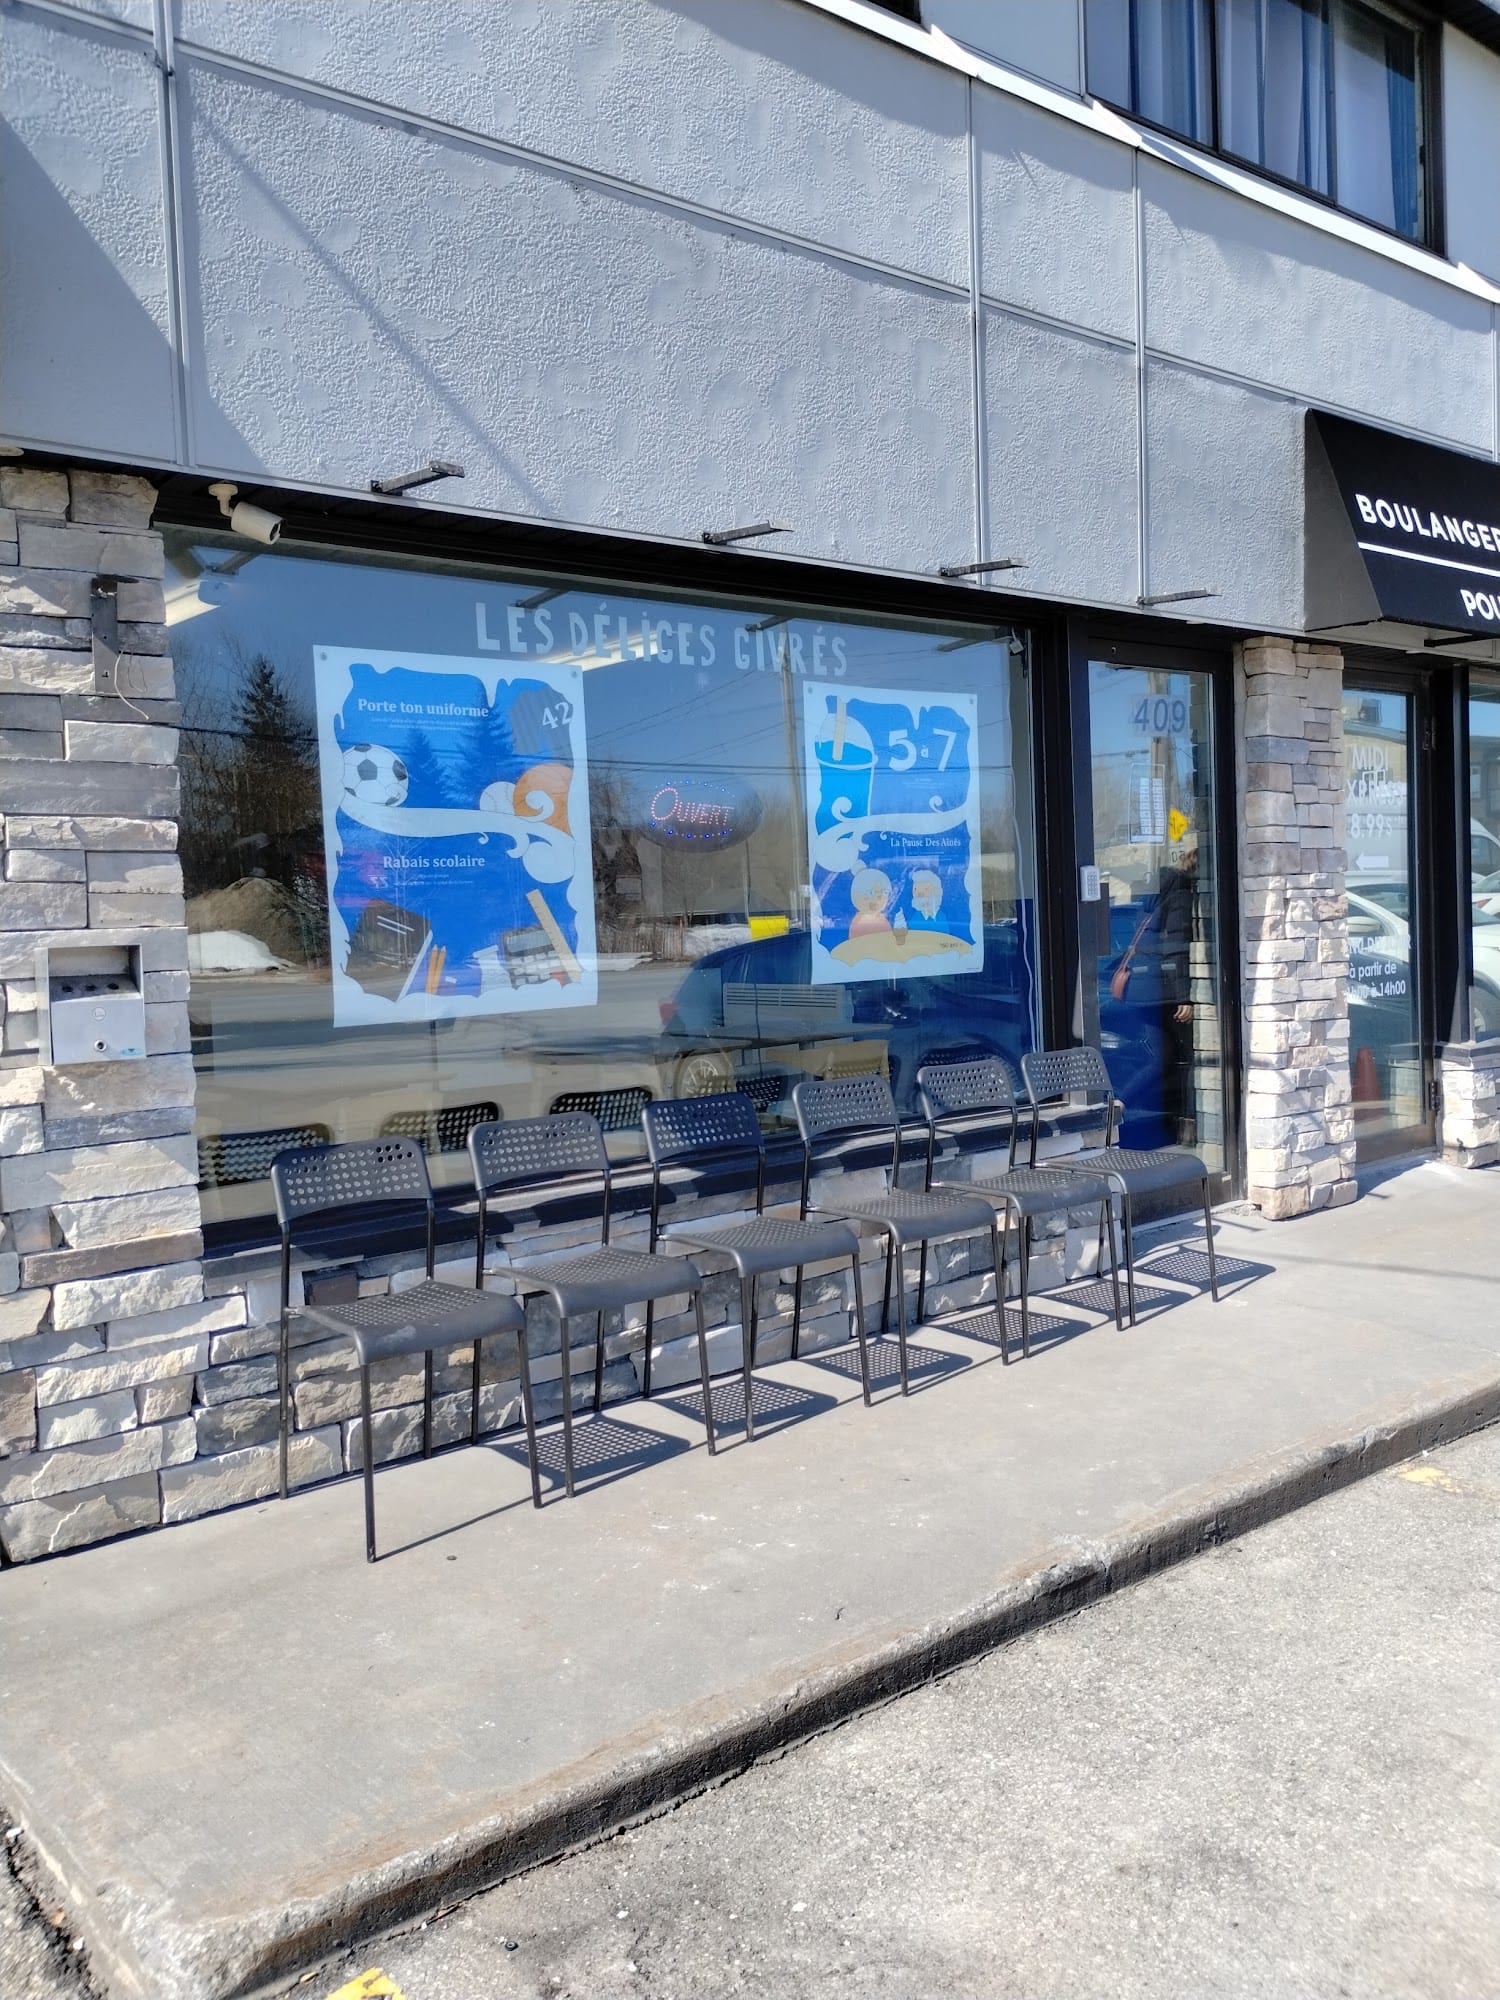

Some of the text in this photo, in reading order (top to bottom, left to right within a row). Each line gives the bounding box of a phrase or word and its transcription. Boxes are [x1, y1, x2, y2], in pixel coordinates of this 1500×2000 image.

[475, 602, 554, 654] LES
[358, 699, 489, 717] Porte ton uniforme
[543, 701, 571, 729] 42
[1134, 697, 1186, 734] 409
[889, 729, 917, 771] 5
[932, 728, 957, 772] 7
[1352, 745, 1389, 771] MIDI
[1350, 813, 1393, 838] 8.99$
[890, 837, 900, 847] La
[902, 837, 924, 848] Pause
[925, 837, 940, 847] Des
[383, 854, 485, 868] Rabais scolaire
[1349, 960, 1397, 981] à partir de
[1379, 980, 1406, 997] 14h00
